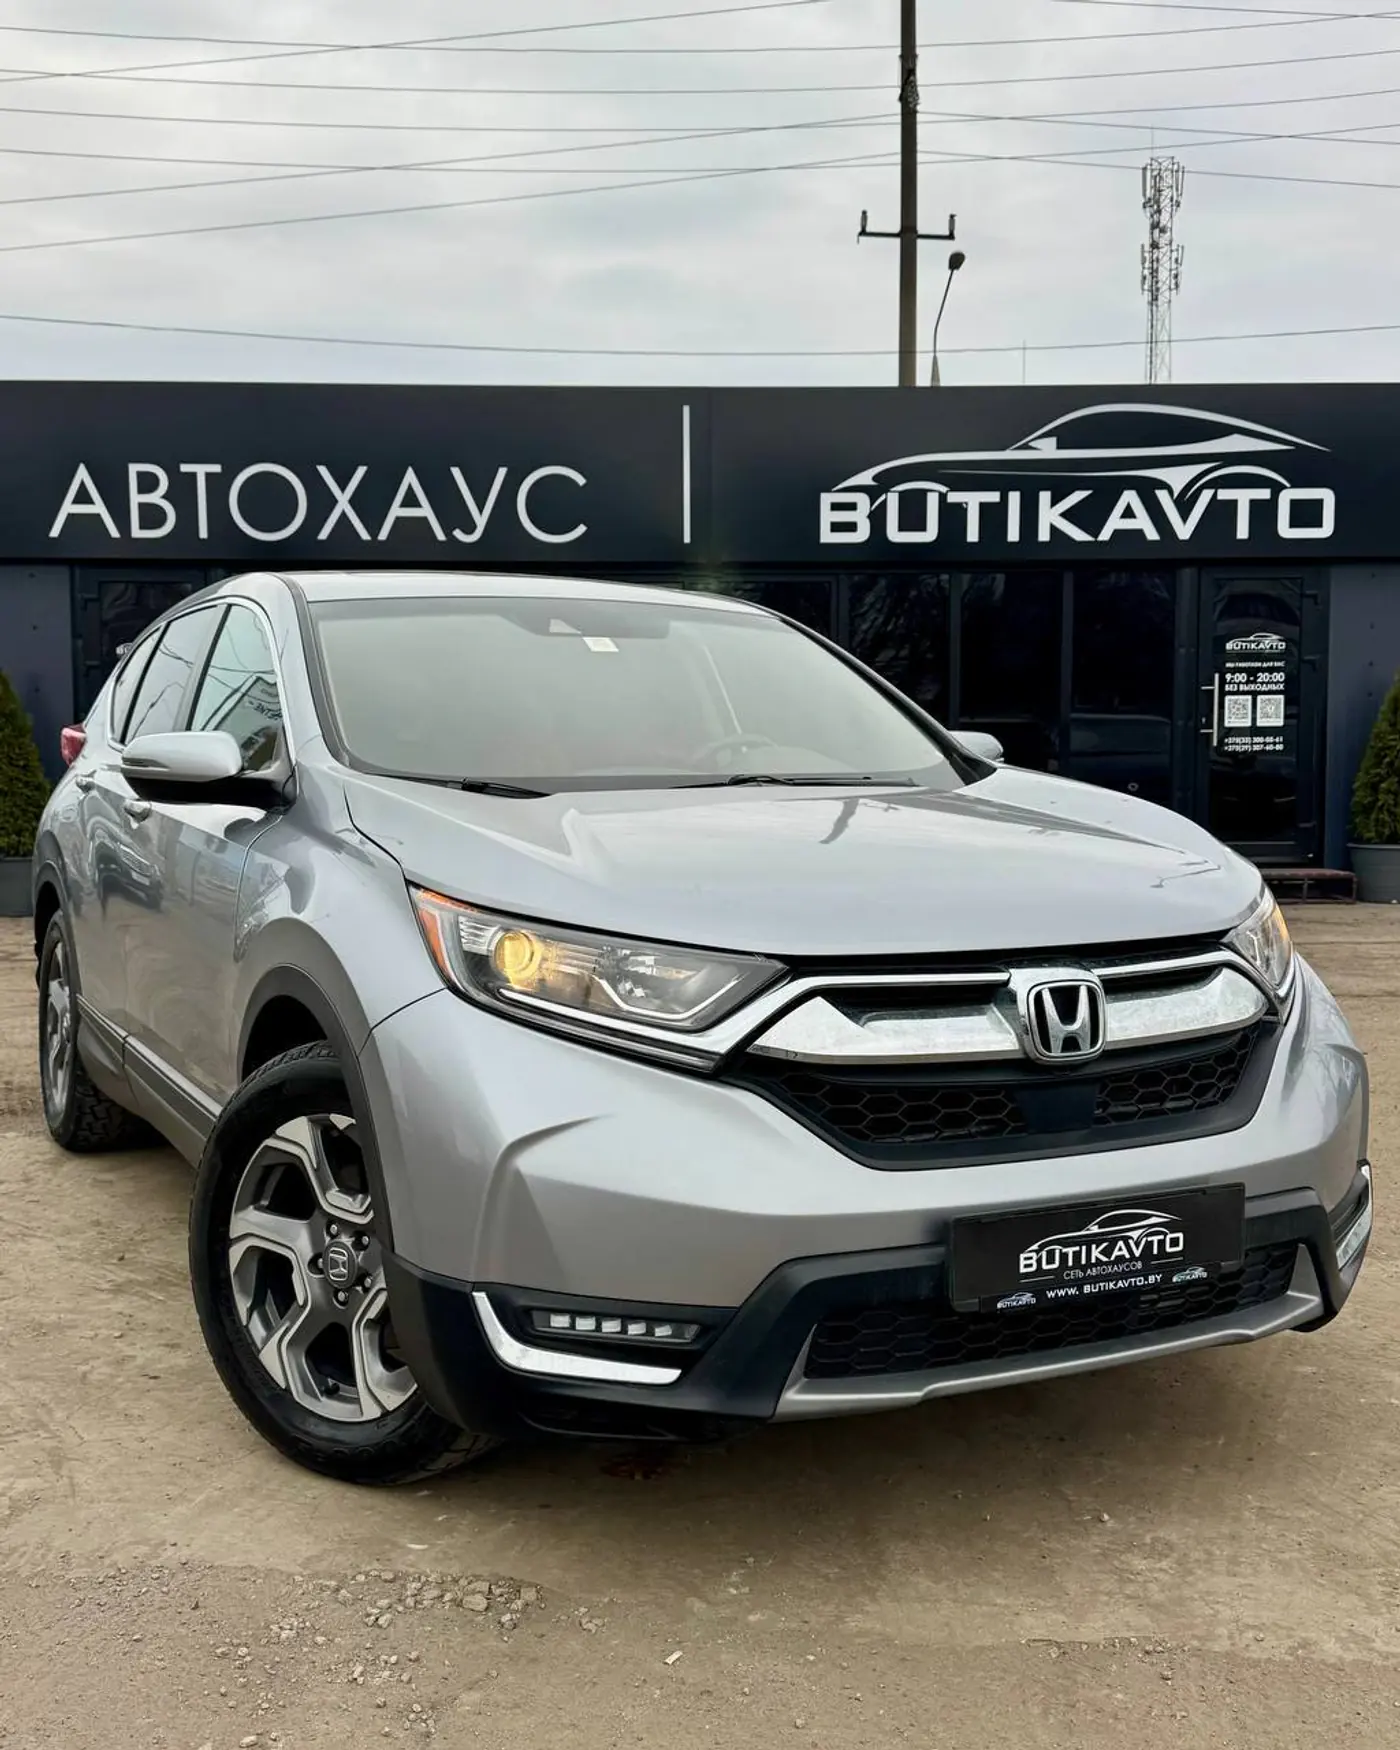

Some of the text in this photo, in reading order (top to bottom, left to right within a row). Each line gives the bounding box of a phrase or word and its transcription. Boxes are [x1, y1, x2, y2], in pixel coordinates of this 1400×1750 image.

[49, 462, 588, 544] АВТОХАУС
[820, 486, 1336, 544] BUTIKAVTO
[1225, 641, 1286, 650] BUTIKAVTO
[1225, 672, 1247, 683] 9:00
[1256, 671, 1285, 682] 20:00
[1225, 683, 1285, 691] БЕЗ ВЫХОДНЫХ
[1019, 1232, 1184, 1274] BUTIKAVTO
[1063, 1260, 1143, 1281] СЕТЬ АВТОХАУСОВ
[1046, 1273, 1163, 1299] WWW. BUTIKAVTO.BY
[997, 1297, 1037, 1309] BUTIKAVTO
